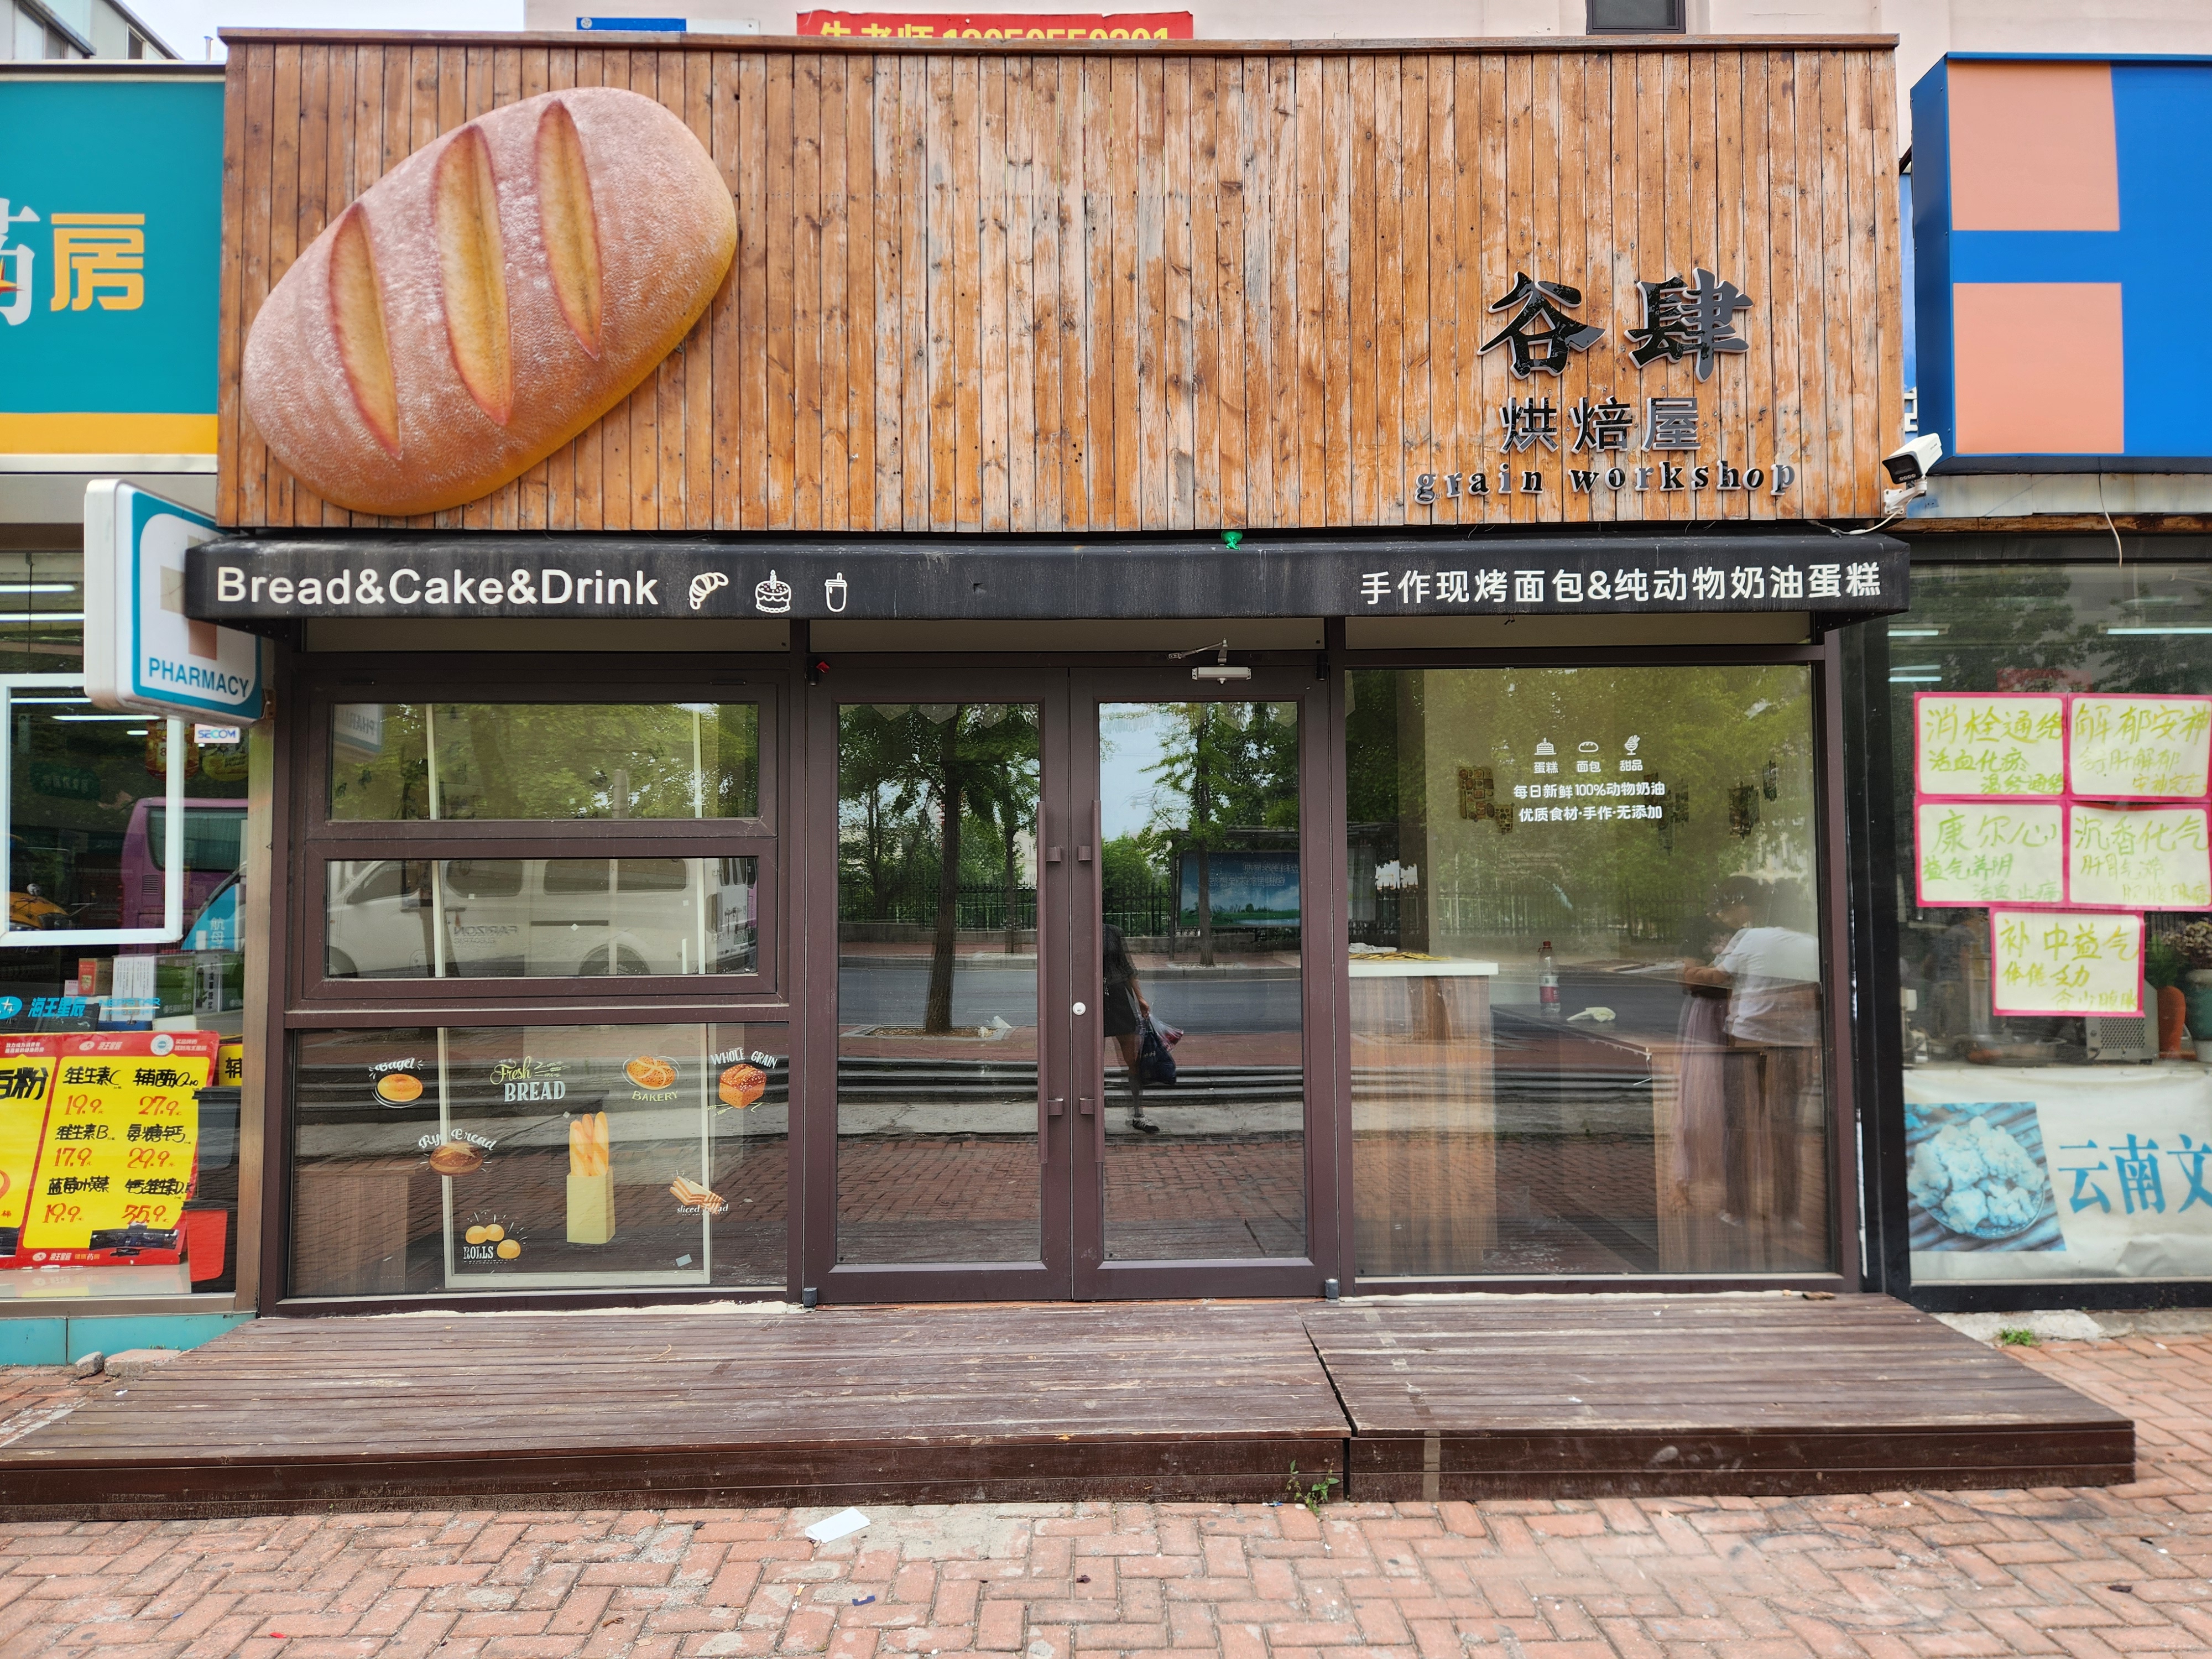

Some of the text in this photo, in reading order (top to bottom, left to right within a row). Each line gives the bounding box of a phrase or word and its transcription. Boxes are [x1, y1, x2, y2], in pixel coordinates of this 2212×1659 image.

[1477, 267, 1754, 383] 谷肆
[1499, 395, 1702, 455] 烘焙屋
[1415, 460, 1796, 505] grain workshop
[216, 566, 659, 605] Bread&Cake&Drink
[1360, 561, 1881, 604] 手作现烤面包&纯动物奶油蛋糕
[149, 656, 249, 698] PHARMACY
[197, 729, 236, 739] SECOM
[2075, 703, 2211, 745] 解郁安神
[1534, 759, 1644, 774] 蛋糕 面包 甜品
[2075, 815, 2209, 855] 沉香化气
[2000, 919, 2139, 961] 补中益气
[28, 997, 87, 1018] 海王星辰
[98, 998, 161, 1007] NEPSTAR
[375, 1057, 415, 1072] Bagel
[490, 1056, 533, 1085] Fresh
[710, 1047, 778, 1069] WHOLE GRAIN
[504, 1081, 566, 1102] BREAD
[632, 1091, 679, 1102] BAKERY
[677, 1204, 701, 1213] sliced
[463, 1246, 493, 1259] ROLLS
